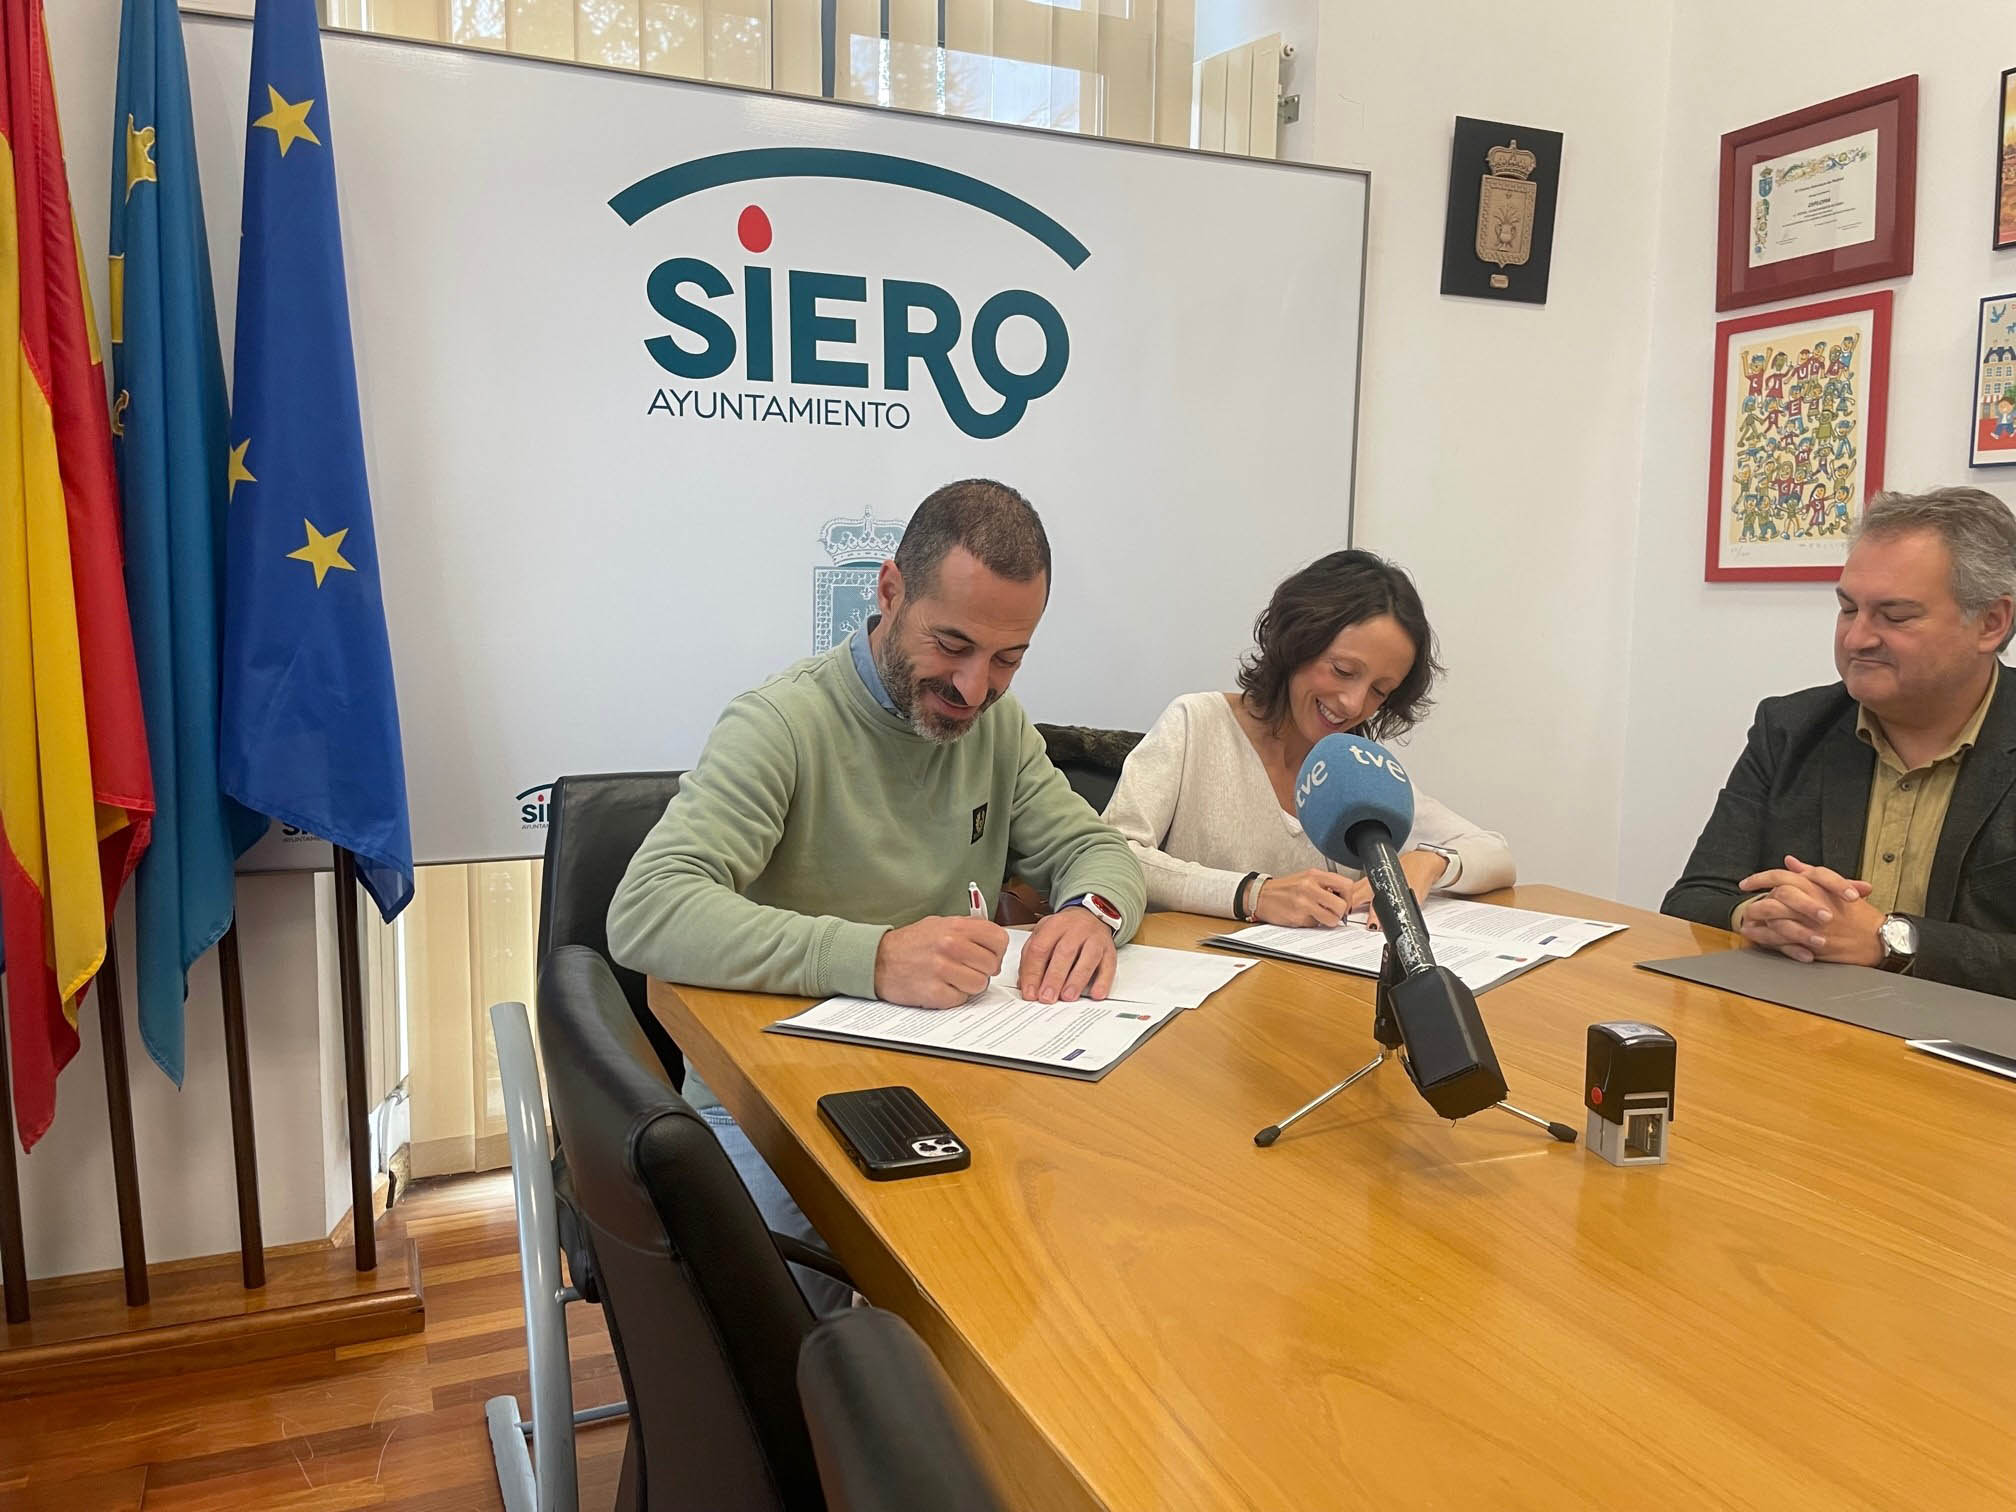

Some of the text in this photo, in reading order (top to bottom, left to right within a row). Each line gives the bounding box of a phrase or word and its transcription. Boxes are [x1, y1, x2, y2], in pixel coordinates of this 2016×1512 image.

[644, 206, 1071, 440] SIERO
[647, 388, 911, 430] AYUNTAMIENTO
[1349, 745, 1407, 783] tve
